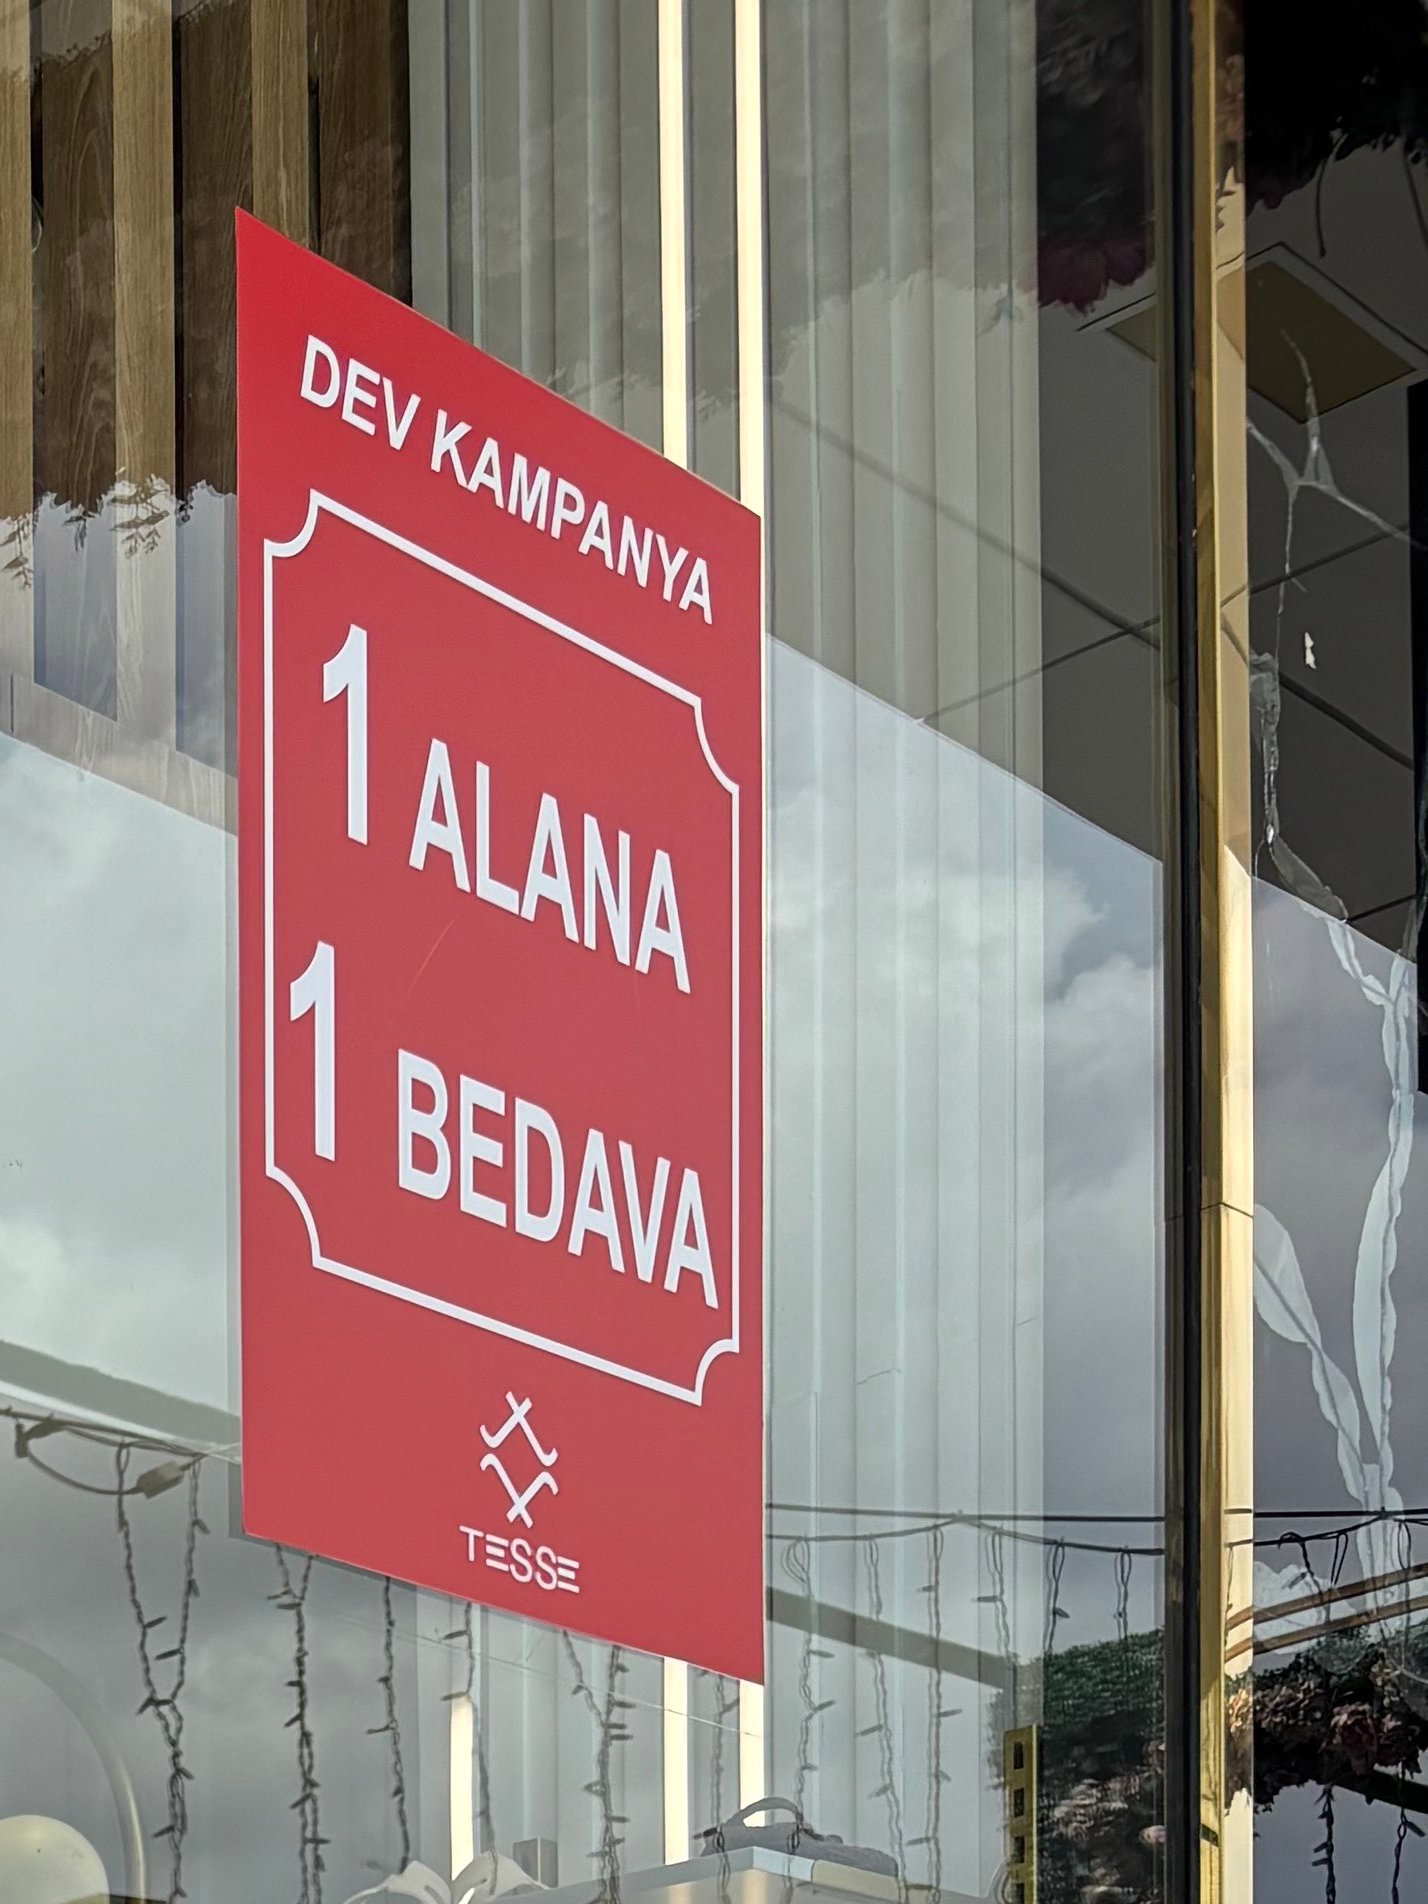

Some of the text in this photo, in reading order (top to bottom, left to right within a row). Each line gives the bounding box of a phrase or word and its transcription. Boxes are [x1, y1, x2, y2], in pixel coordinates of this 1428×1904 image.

[300, 334, 713, 625] DEV KAMPANYA
[322, 623, 691, 994] 1 ALANA
[289, 940, 719, 1310] 1 BEDAVA
[459, 1525, 580, 1593] TESSE
